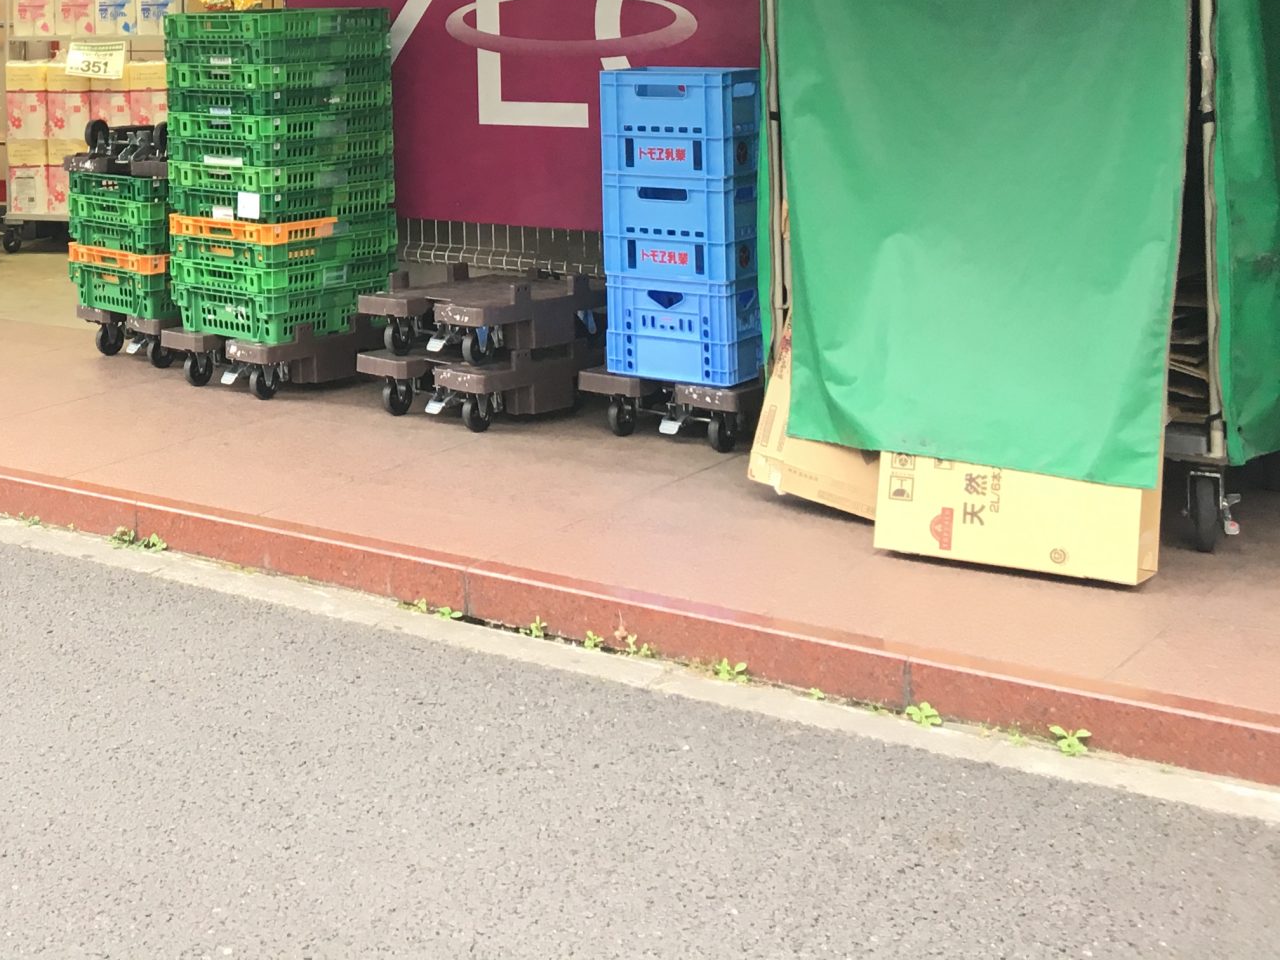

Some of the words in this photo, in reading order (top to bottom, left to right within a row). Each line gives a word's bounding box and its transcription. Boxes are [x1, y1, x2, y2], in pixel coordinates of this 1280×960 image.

[80, 60, 108, 74] 351
[963, 473, 987, 526] 天然
[990, 467, 1002, 513] 2L/6本
